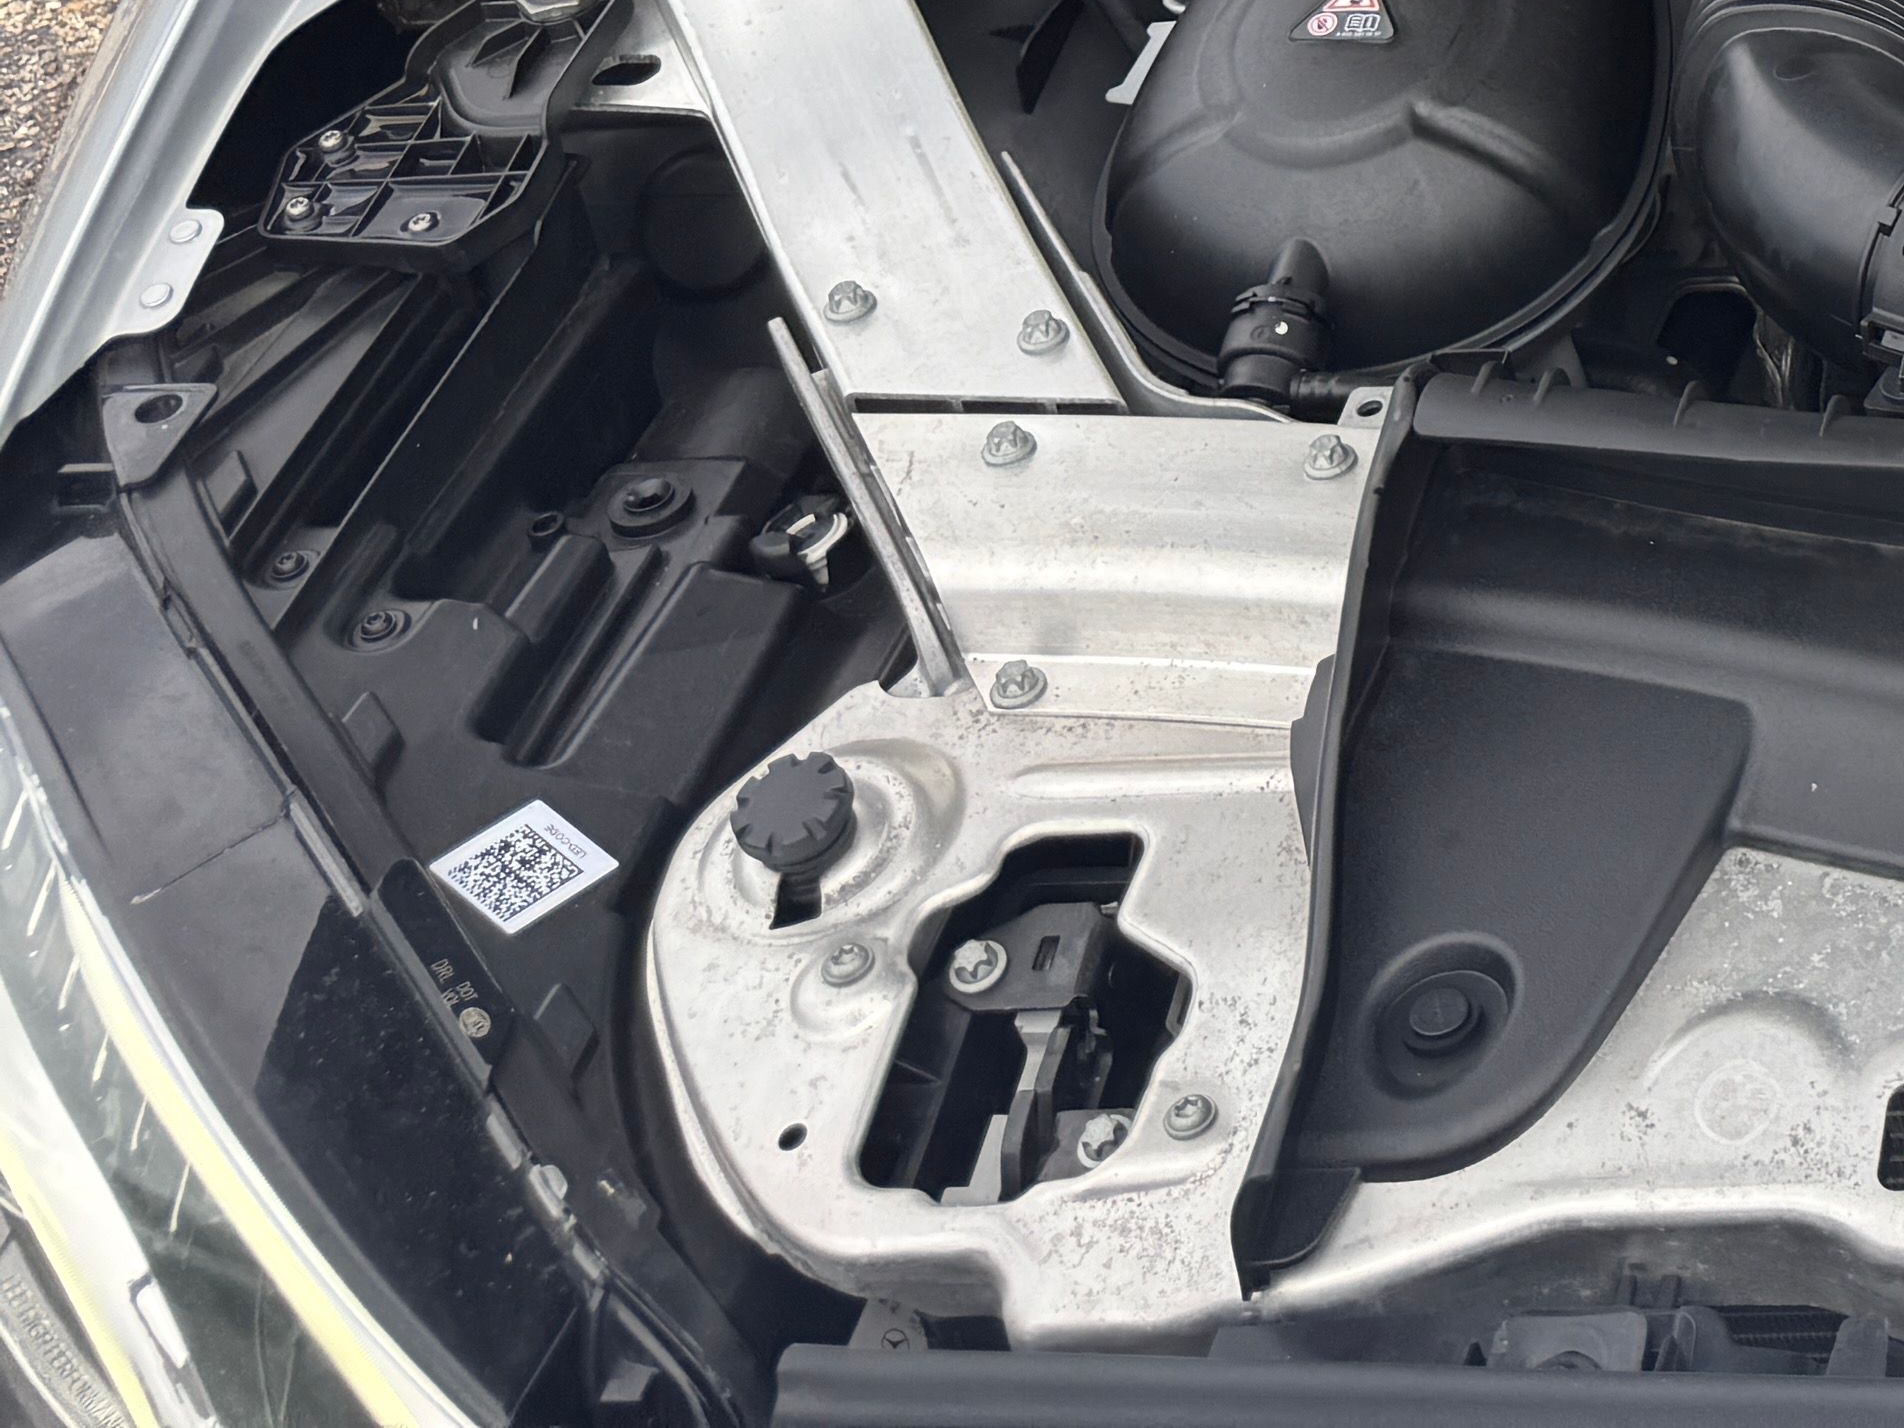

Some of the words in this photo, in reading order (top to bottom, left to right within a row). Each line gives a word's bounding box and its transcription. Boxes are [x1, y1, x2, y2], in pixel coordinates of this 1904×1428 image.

[543, 822, 588, 860] LED-CODE
[429, 958, 453, 989] DRL
[456, 981, 480, 1003] DOT
[41, 1342, 125, 1428] PERFORMAN
